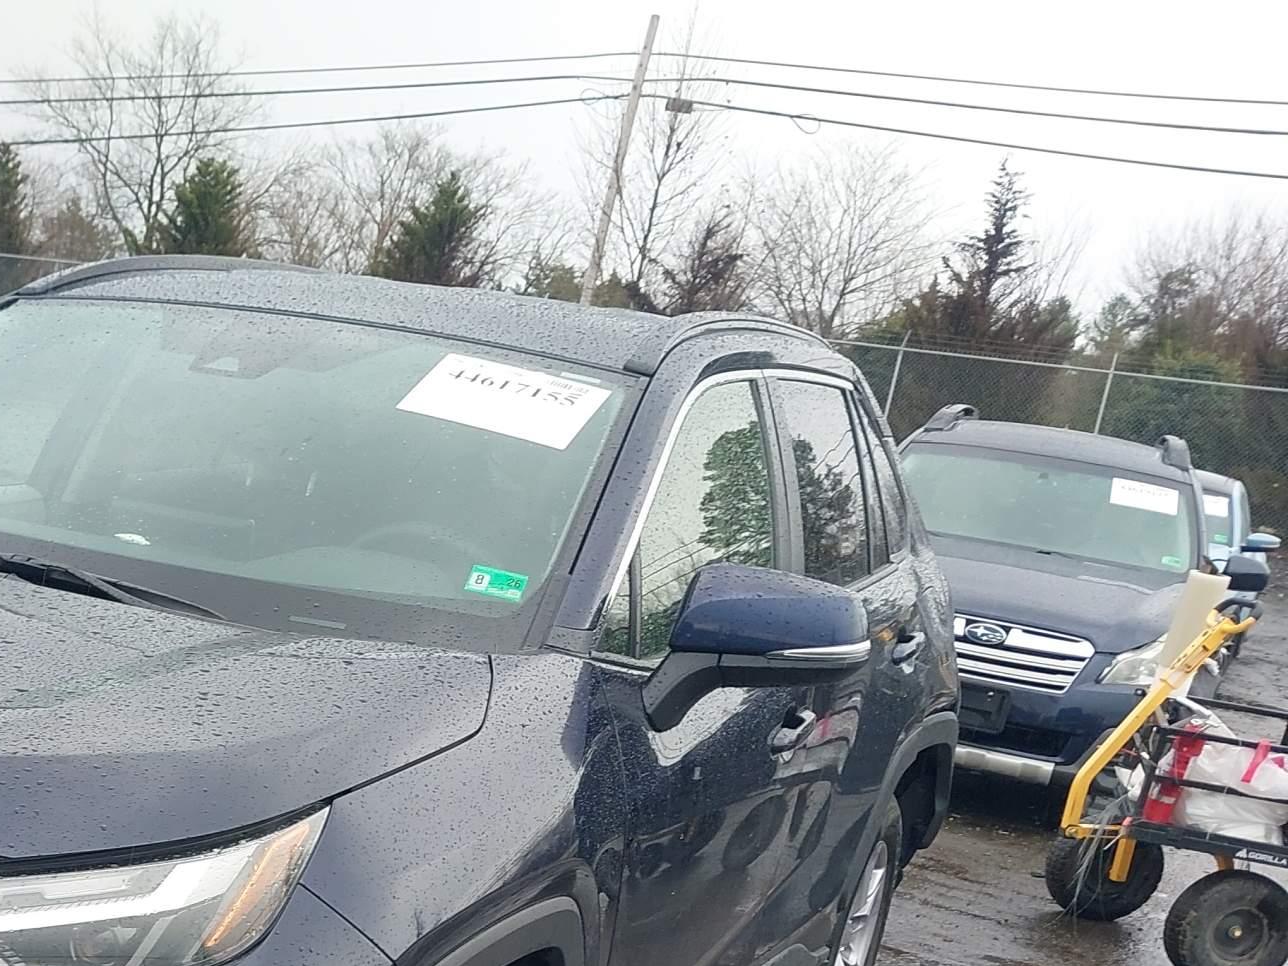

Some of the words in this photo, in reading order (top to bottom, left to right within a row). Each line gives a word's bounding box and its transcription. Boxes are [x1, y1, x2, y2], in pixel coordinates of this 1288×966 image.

[449, 370, 583, 406] 44617155
[475, 574, 485, 585] 8
[506, 577, 521, 589] 26
[1248, 851, 1287, 865] GORILLA
